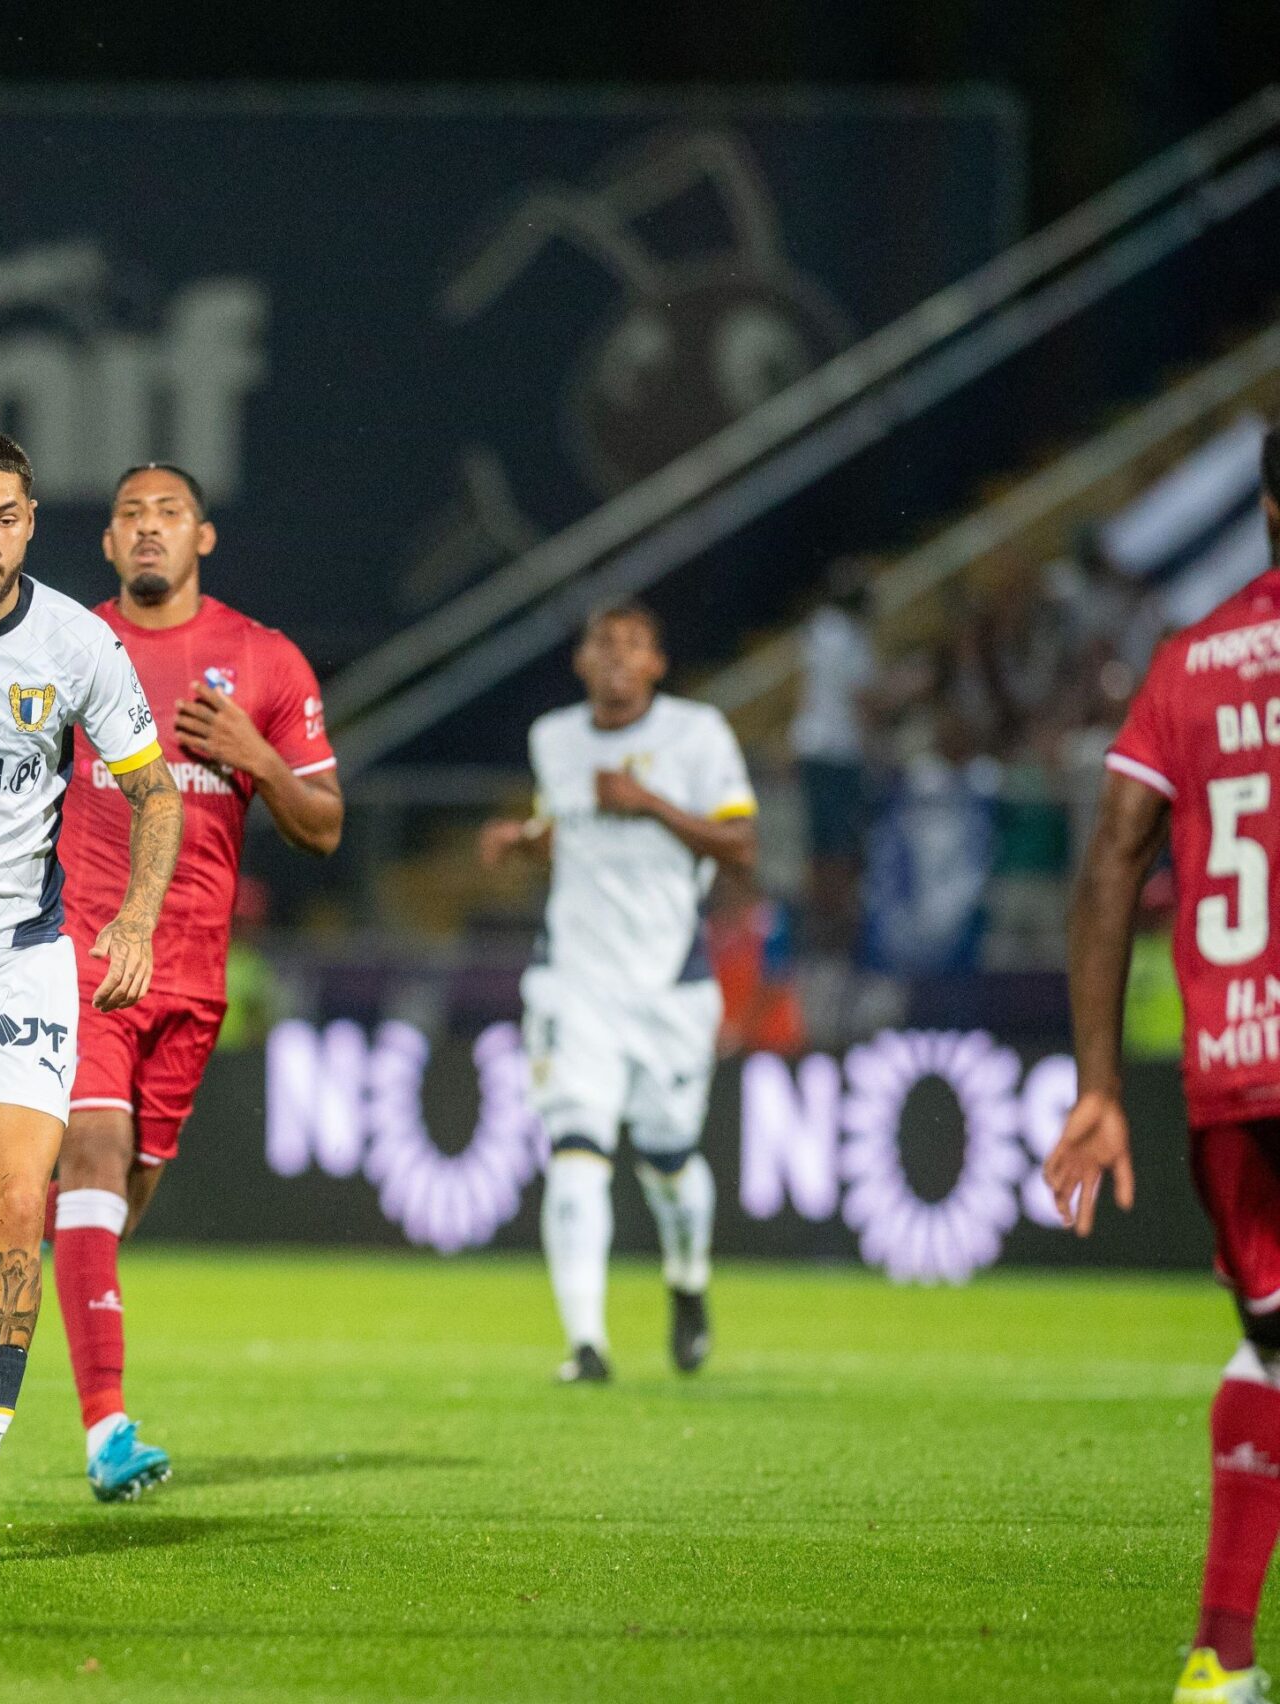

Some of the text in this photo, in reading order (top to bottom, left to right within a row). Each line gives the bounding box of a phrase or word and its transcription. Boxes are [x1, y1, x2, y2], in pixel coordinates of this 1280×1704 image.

[133, 710, 153, 735] GRO
[1197, 772, 1270, 964] 5
[1197, 1016, 1280, 1072] MOT
